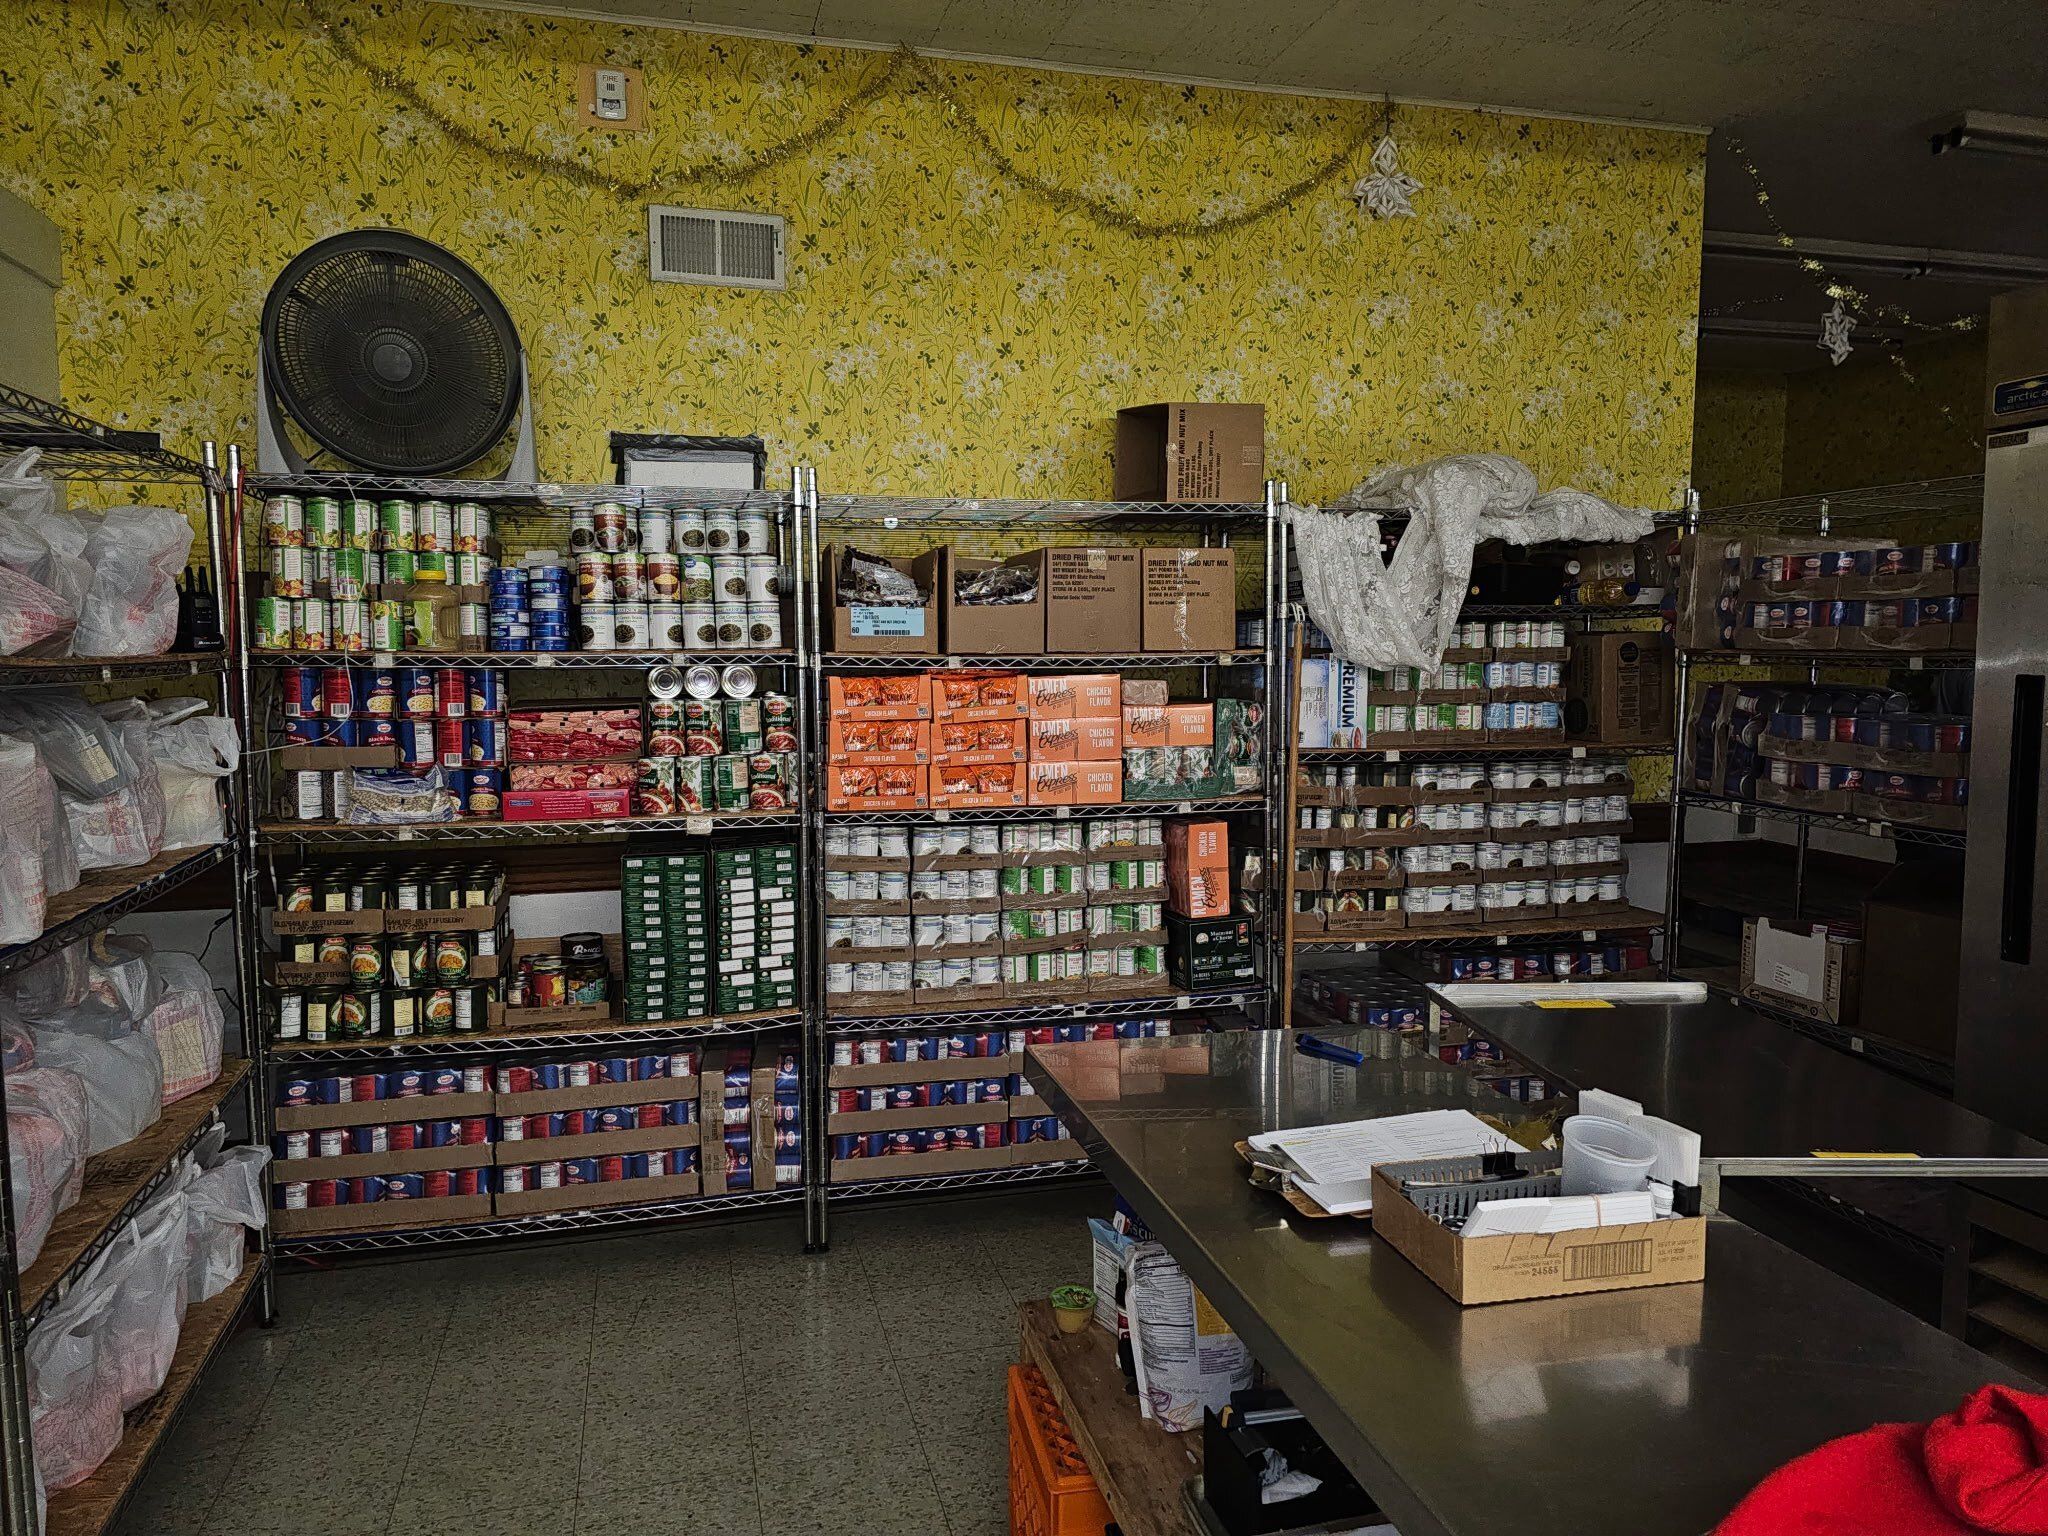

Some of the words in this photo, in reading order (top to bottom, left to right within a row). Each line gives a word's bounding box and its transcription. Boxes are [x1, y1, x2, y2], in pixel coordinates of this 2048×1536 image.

[2007, 390, 2039, 404] arctic
[1052, 553, 1072, 561] DRIED
[1073, 553, 1091, 561] FRUIT
[1108, 554, 1121, 562] NUT
[1122, 554, 1135, 562] MIX
[852, 626, 859, 634] 60
[1029, 680, 1067, 694] RAMEN
[1086, 687, 1112, 697] CHICKEN
[1035, 687, 1077, 707] Express
[1090, 697, 1111, 707] FLAVOR
[1131, 715, 1170, 734] Express
[1180, 714, 1206, 724] CHICKEN
[1032, 720, 1070, 737] RAMEN
[1089, 728, 1115, 737] CHICKEN
[1184, 725, 1205, 734] FLAVOR
[1039, 729, 1079, 749] Express
[1092, 738, 1114, 748] FLAVOR
[1031, 765, 1068, 780] RAMEN
[1087, 773, 1114, 782] CHICKEN
[1036, 772, 1077, 793] Express
[1091, 783, 1113, 793] FLAVOR
[1199, 831, 1207, 857] CHICKEN
[1208, 831, 1217, 854] FLAVOR
[1199, 867, 1218, 909] Express
[1191, 876, 1206, 915] RAMEN
[1136, 1253, 1165, 1262] Nutrition
